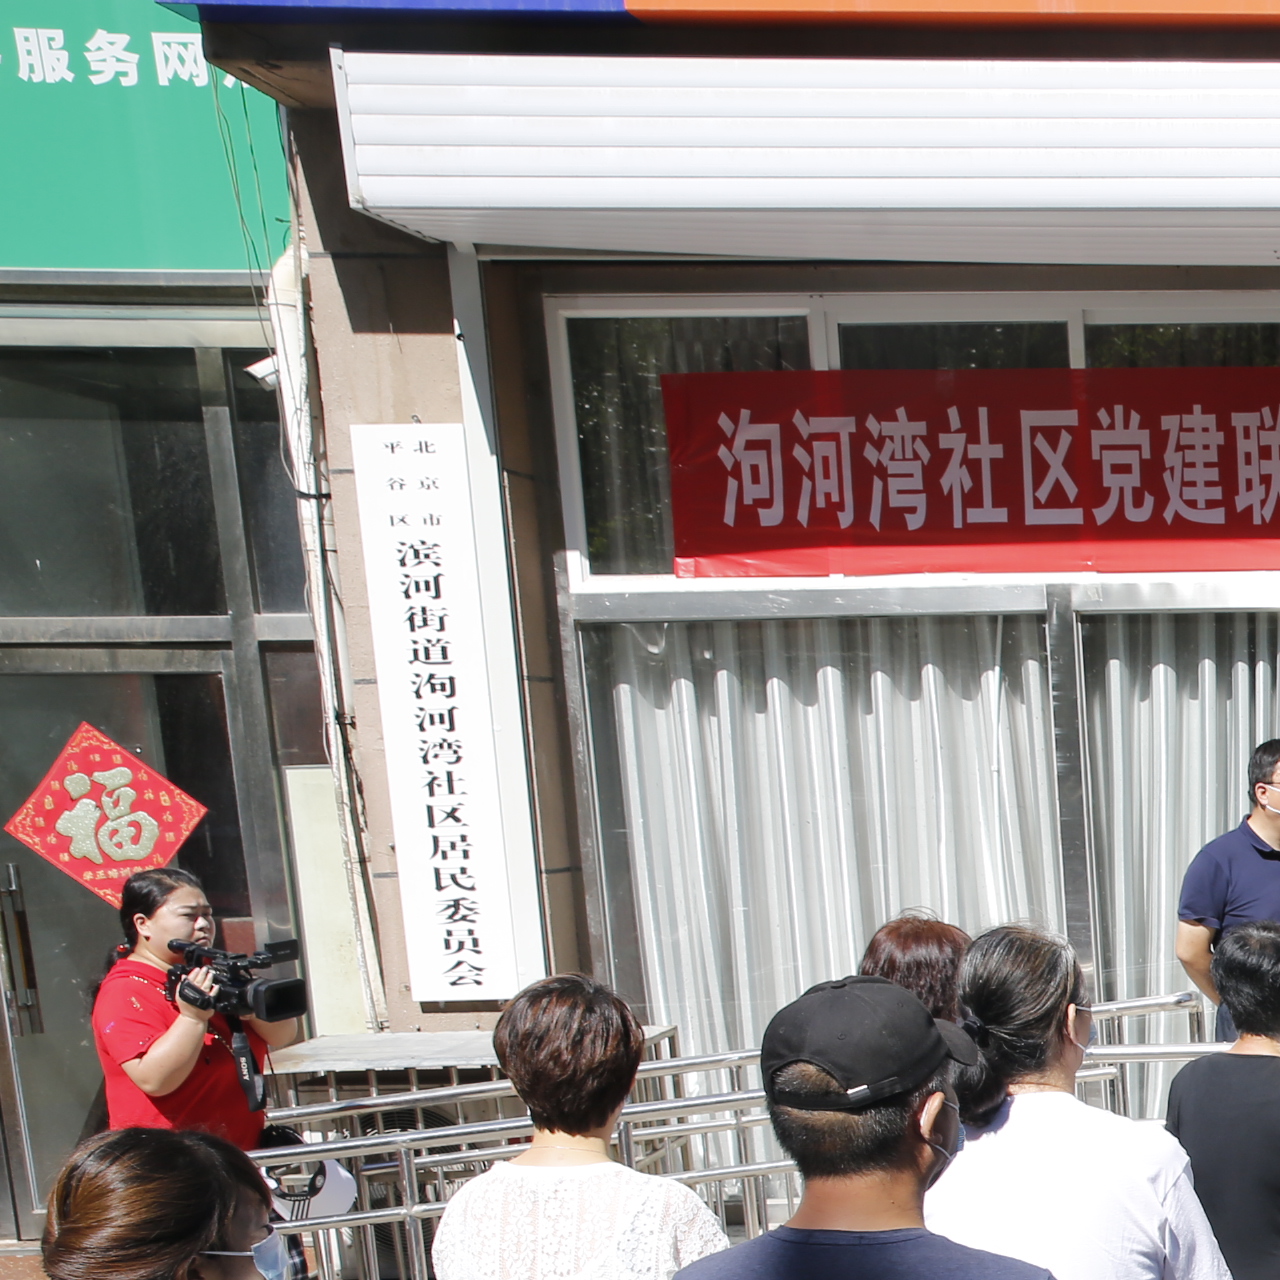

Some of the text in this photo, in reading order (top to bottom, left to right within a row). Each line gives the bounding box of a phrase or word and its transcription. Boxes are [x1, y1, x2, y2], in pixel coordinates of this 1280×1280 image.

[0, 27, 252, 88] 服务网
[382, 441, 410, 527] 平谷区
[413, 440, 442, 527] 北京市
[395, 540, 487, 987] 滨河街道泃河湾社区居民委员会
[55, 766, 159, 865] 福
[239, 1056, 250, 1081] SONY
